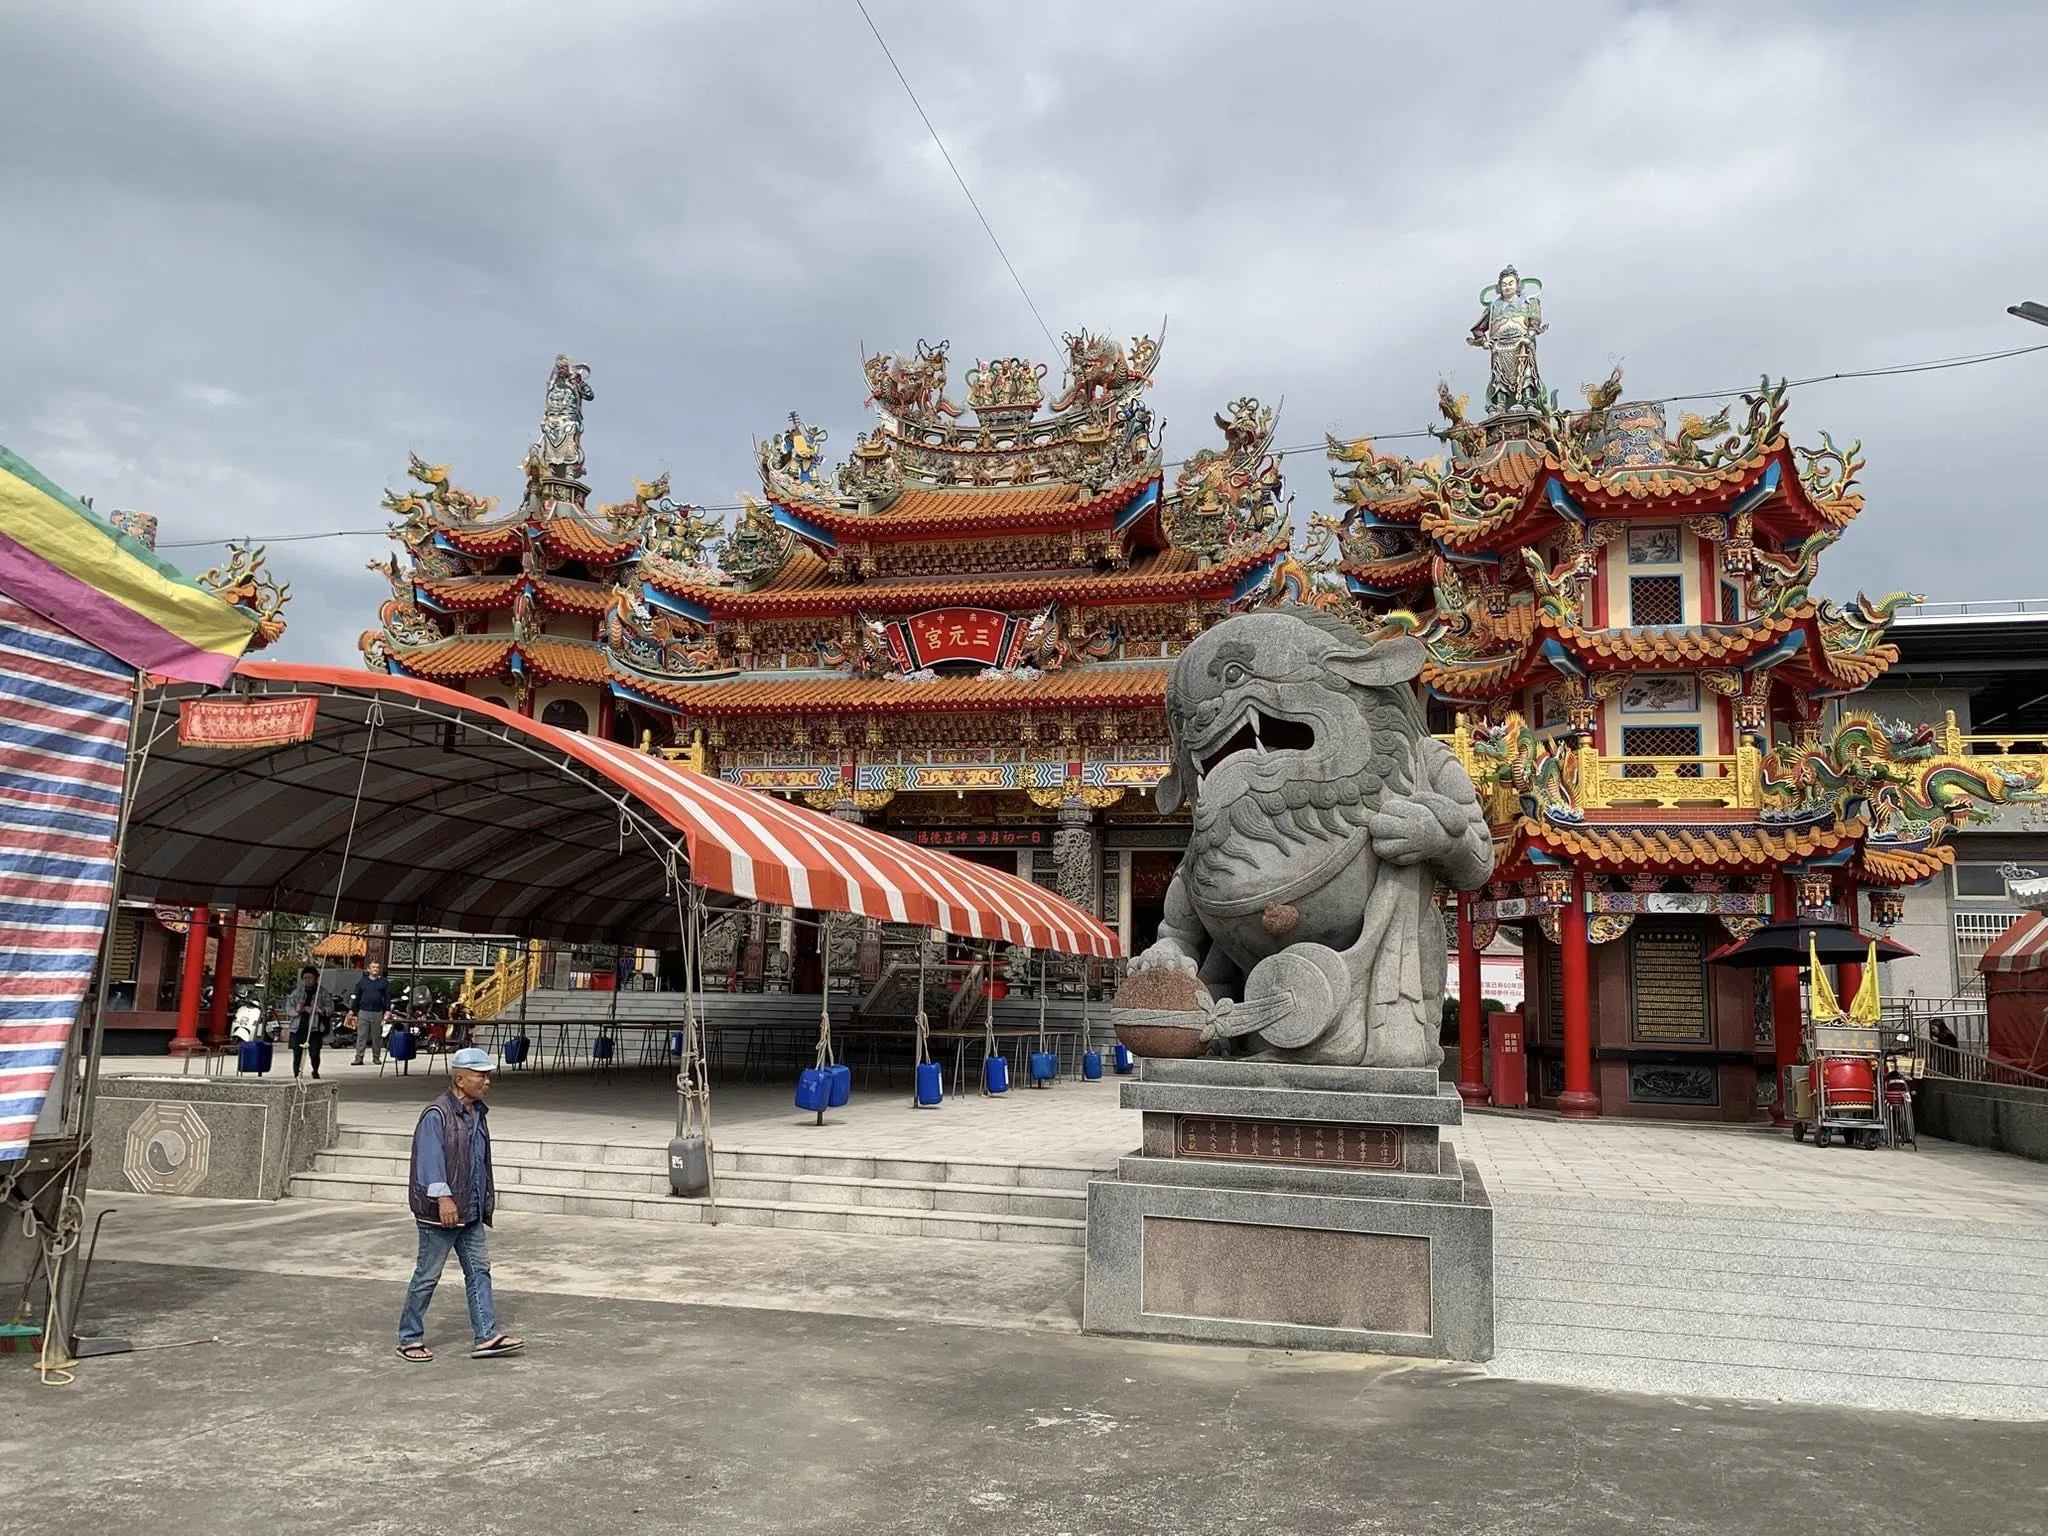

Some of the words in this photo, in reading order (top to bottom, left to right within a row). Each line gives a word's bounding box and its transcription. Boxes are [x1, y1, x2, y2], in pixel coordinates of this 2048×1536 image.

[925, 625, 990, 650] 三元宮
[918, 831, 968, 844] 福德正神
[976, 831, 1040, 844] 每月初一日
